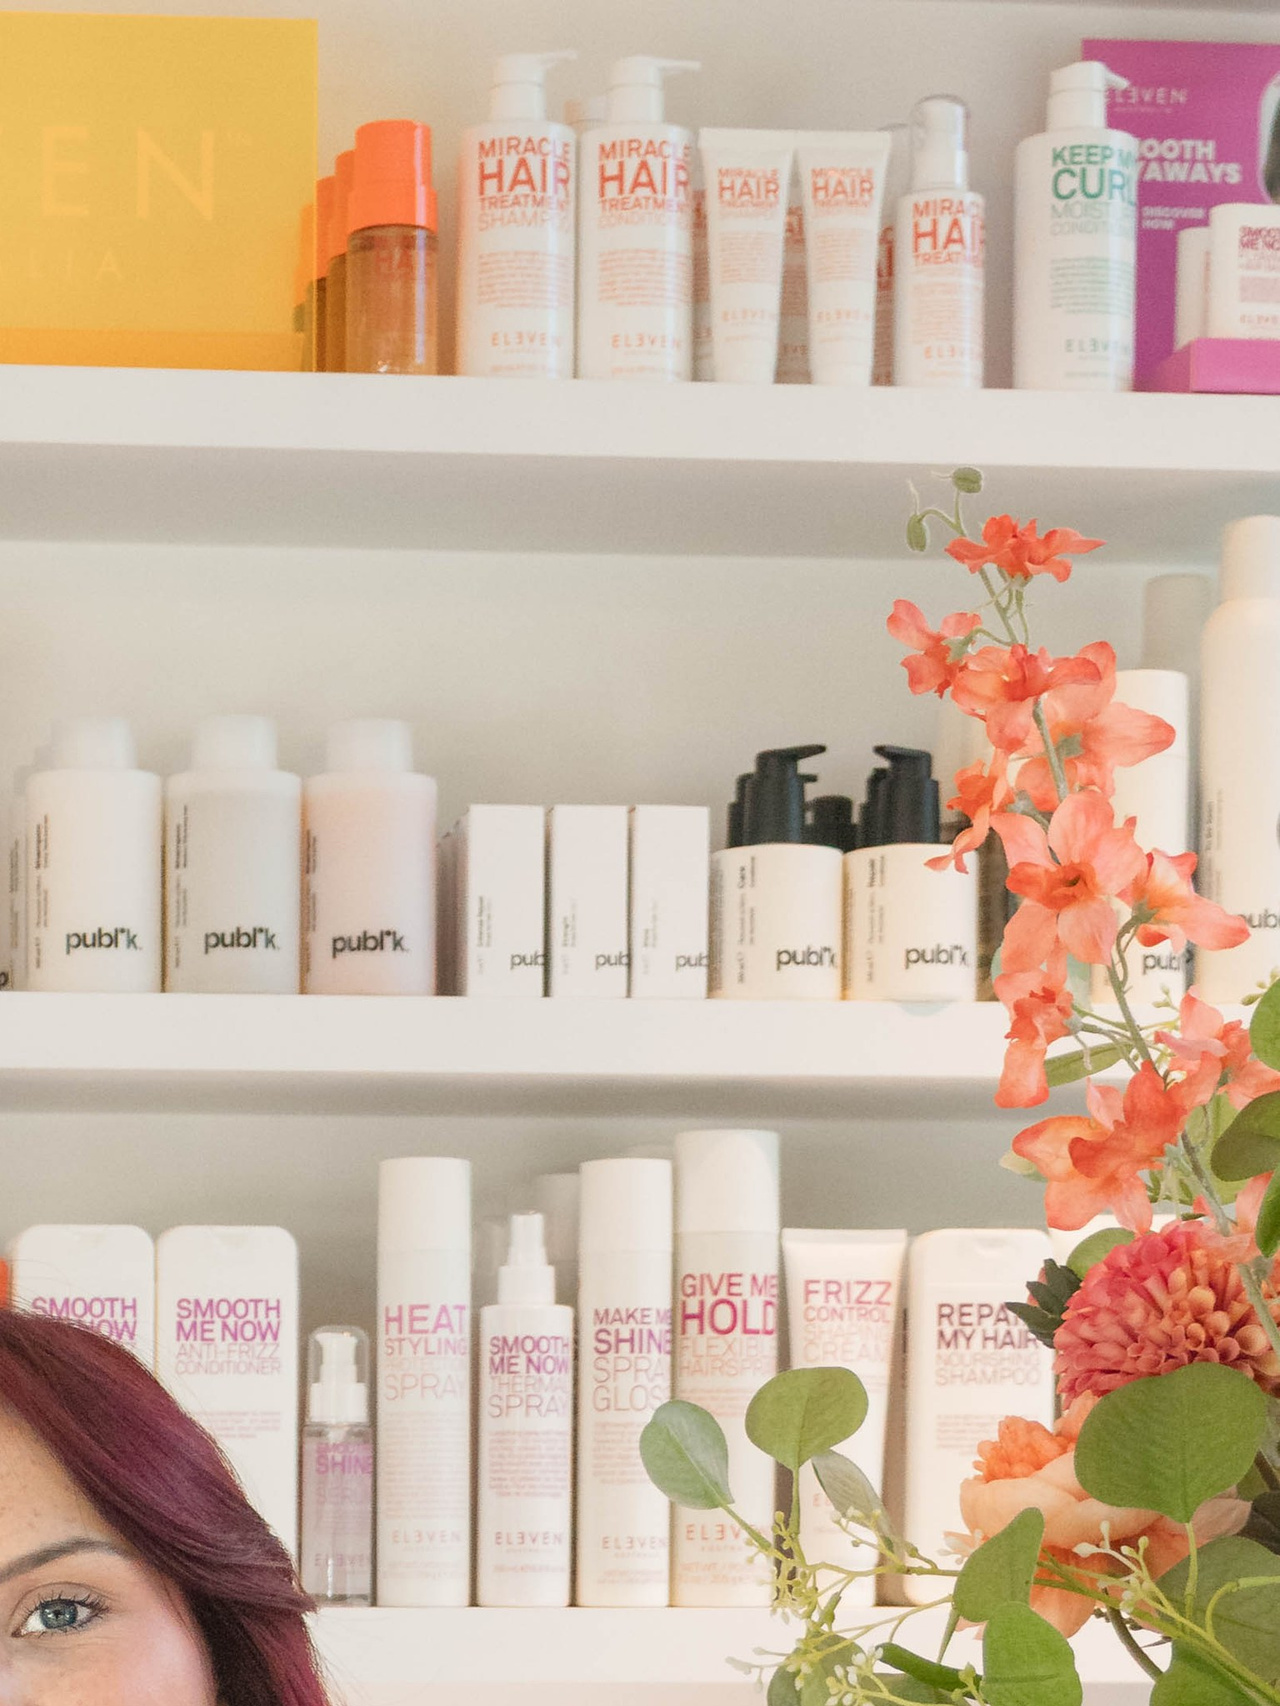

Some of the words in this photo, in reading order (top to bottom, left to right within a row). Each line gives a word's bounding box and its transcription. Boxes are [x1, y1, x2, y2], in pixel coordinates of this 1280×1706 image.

[478, 136, 570, 161] MIRACLE
[598, 138, 691, 162] MIRACLE
[1052, 144, 1114, 167] KEEP
[1138, 138, 1216, 160] OOTH
[478, 158, 571, 197] HAIR
[599, 160, 691, 199] HAIR
[1138, 160, 1242, 184] AWAYS
[719, 178, 780, 202] HAIR
[811, 179, 874, 201] HAIR
[1051, 167, 1137, 206] CURL
[681, 1273, 743, 1298] GIVE
[750, 1273, 777, 1299] ME
[804, 1279, 892, 1307] FRIZZ
[32, 1297, 137, 1319] SMOOTH
[176, 1298, 281, 1320] SMOOTH
[593, 1307, 652, 1327] MAKE
[680, 1299, 777, 1337] HOLD
[804, 1306, 891, 1325] CONTROL
[937, 1303, 1022, 1327] REPA
[176, 1320, 214, 1342] ME
[222, 1320, 281, 1342] NOW
[384, 1304, 467, 1336] HEAT
[176, 1342, 280, 1361] ANTI-FRIZZ
[384, 1336, 467, 1357] STYLING
[489, 1335, 569, 1358] SMOOTH
[593, 1328, 672, 1356] SHINE
[937, 1329, 974, 1350] MY
[982, 1329, 1038, 1351] HAIR
[175, 1360, 281, 1376] CONDITIONER
[489, 1354, 520, 1377] ME
[526, 1354, 568, 1376] NOW
[936, 1367, 1040, 1386] SHAMPOO
[488, 1393, 568, 1420] SPRAY
